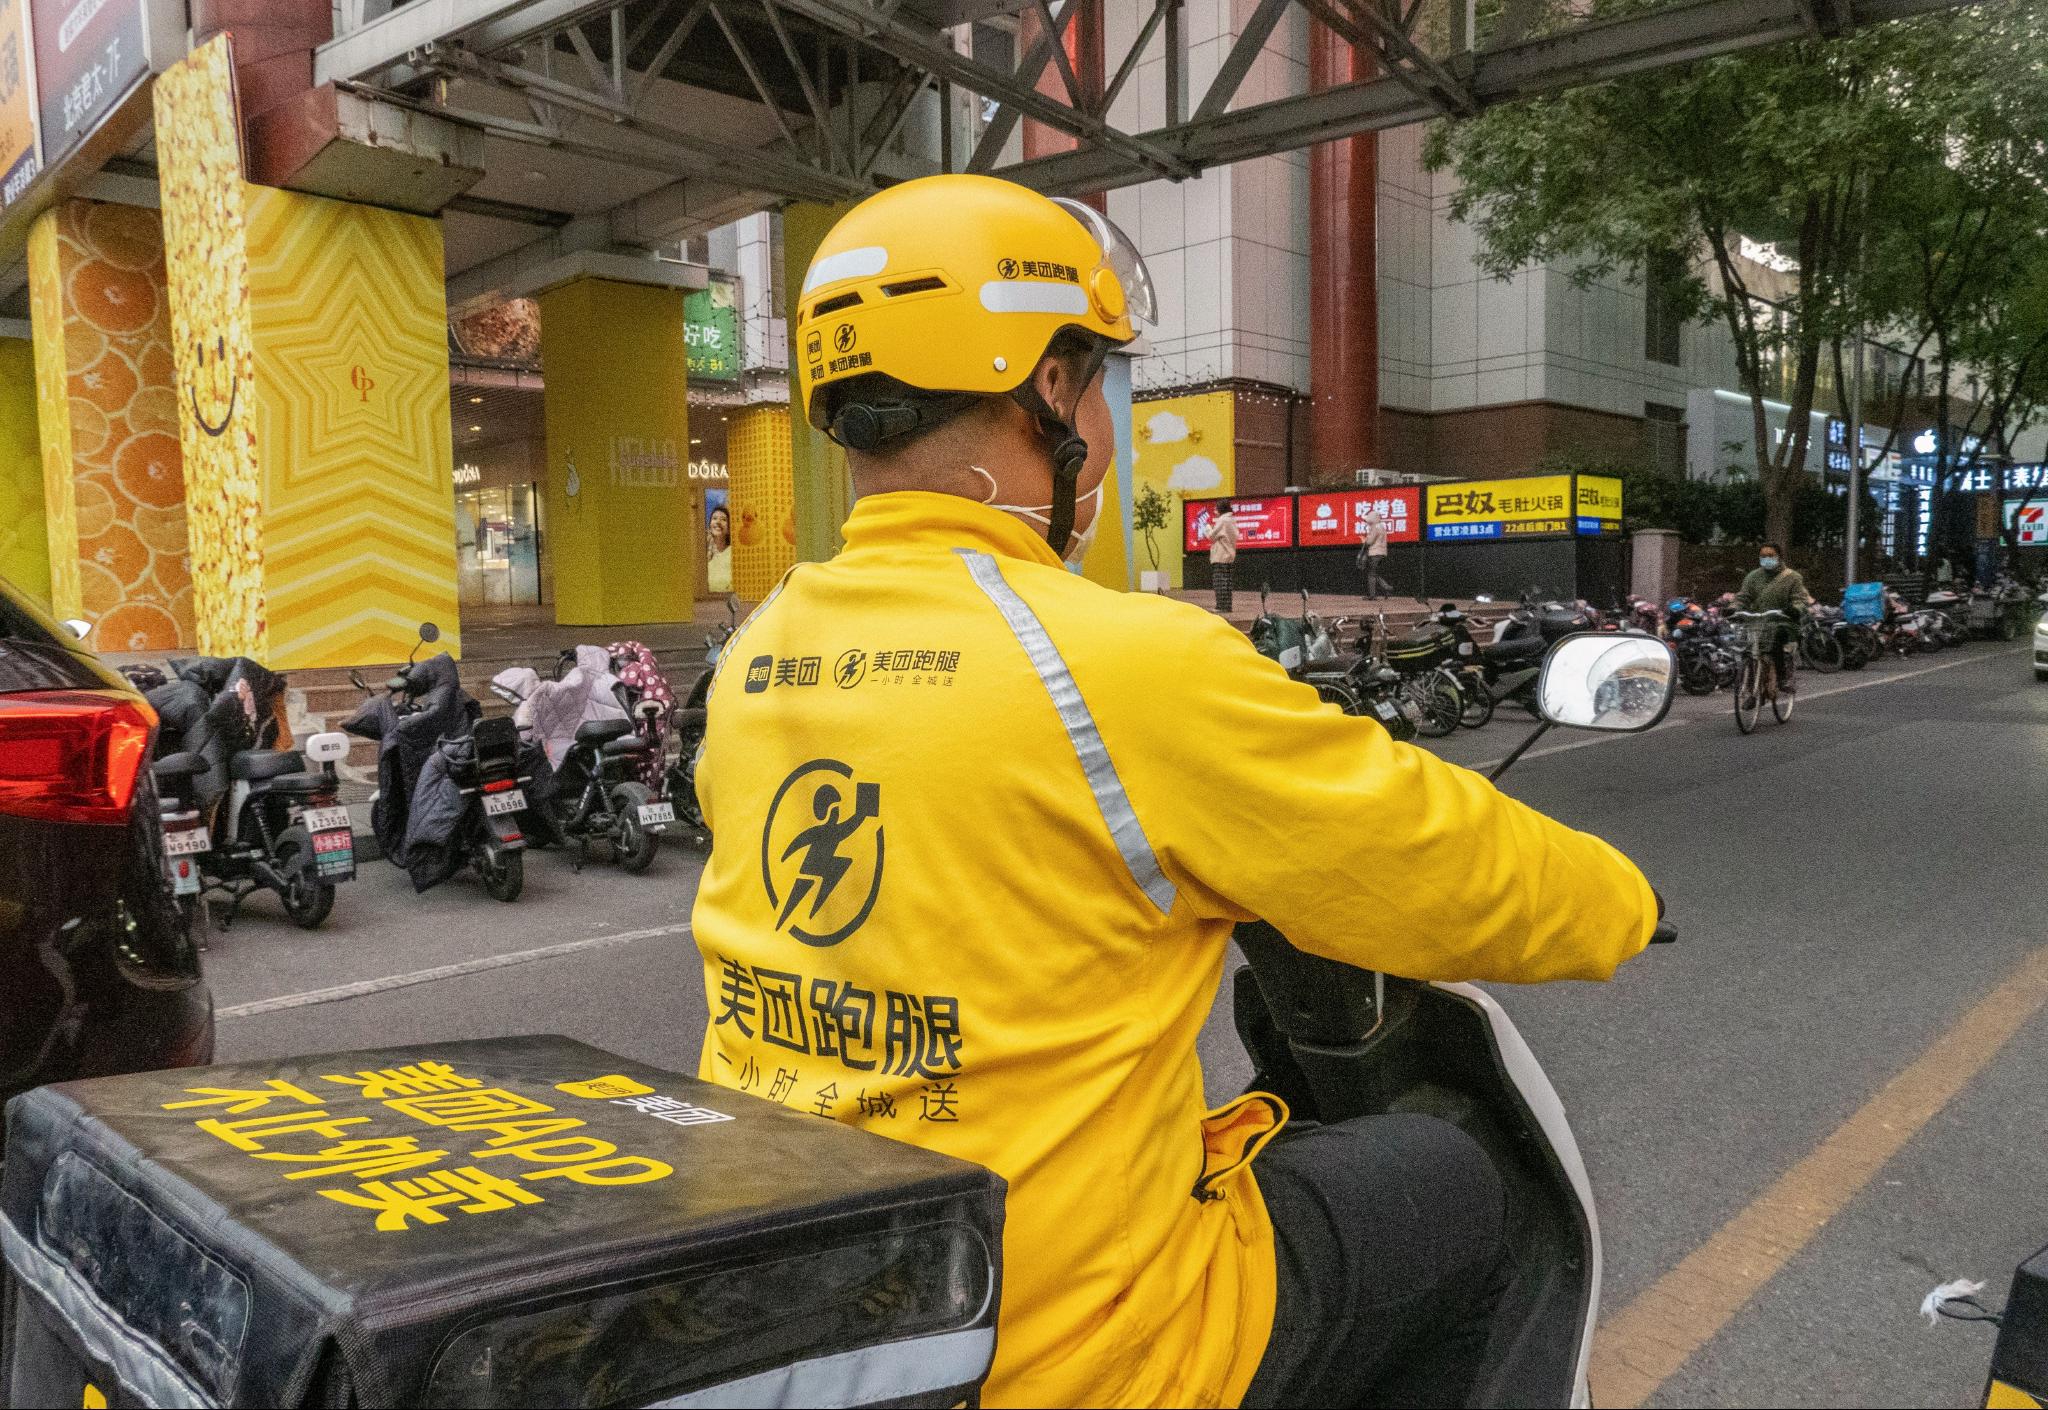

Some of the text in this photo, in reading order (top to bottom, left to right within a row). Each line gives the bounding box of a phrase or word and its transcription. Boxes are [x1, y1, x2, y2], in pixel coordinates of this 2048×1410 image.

[1022, 260, 1080, 283] 美团跑腿
[808, 340, 820, 354] 美团
[810, 364, 824, 382] 美团
[829, 352, 872, 374] 美团跑腿
[1355, 498, 1407, 520] 吃烤鱼
[1435, 490, 1563, 516] 巴奴 毛肚火锅
[748, 650, 961, 687] 美团 美团 美团跑腿
[870, 675, 954, 687] 一小时全城送
[715, 954, 962, 1080] 美团跑腿
[717, 1051, 960, 1122] 一小时全城送
[320, 1061, 674, 1186] 美团APP
[609, 1095, 736, 1126] 美团
[161, 1079, 545, 1232] 不止外卖
